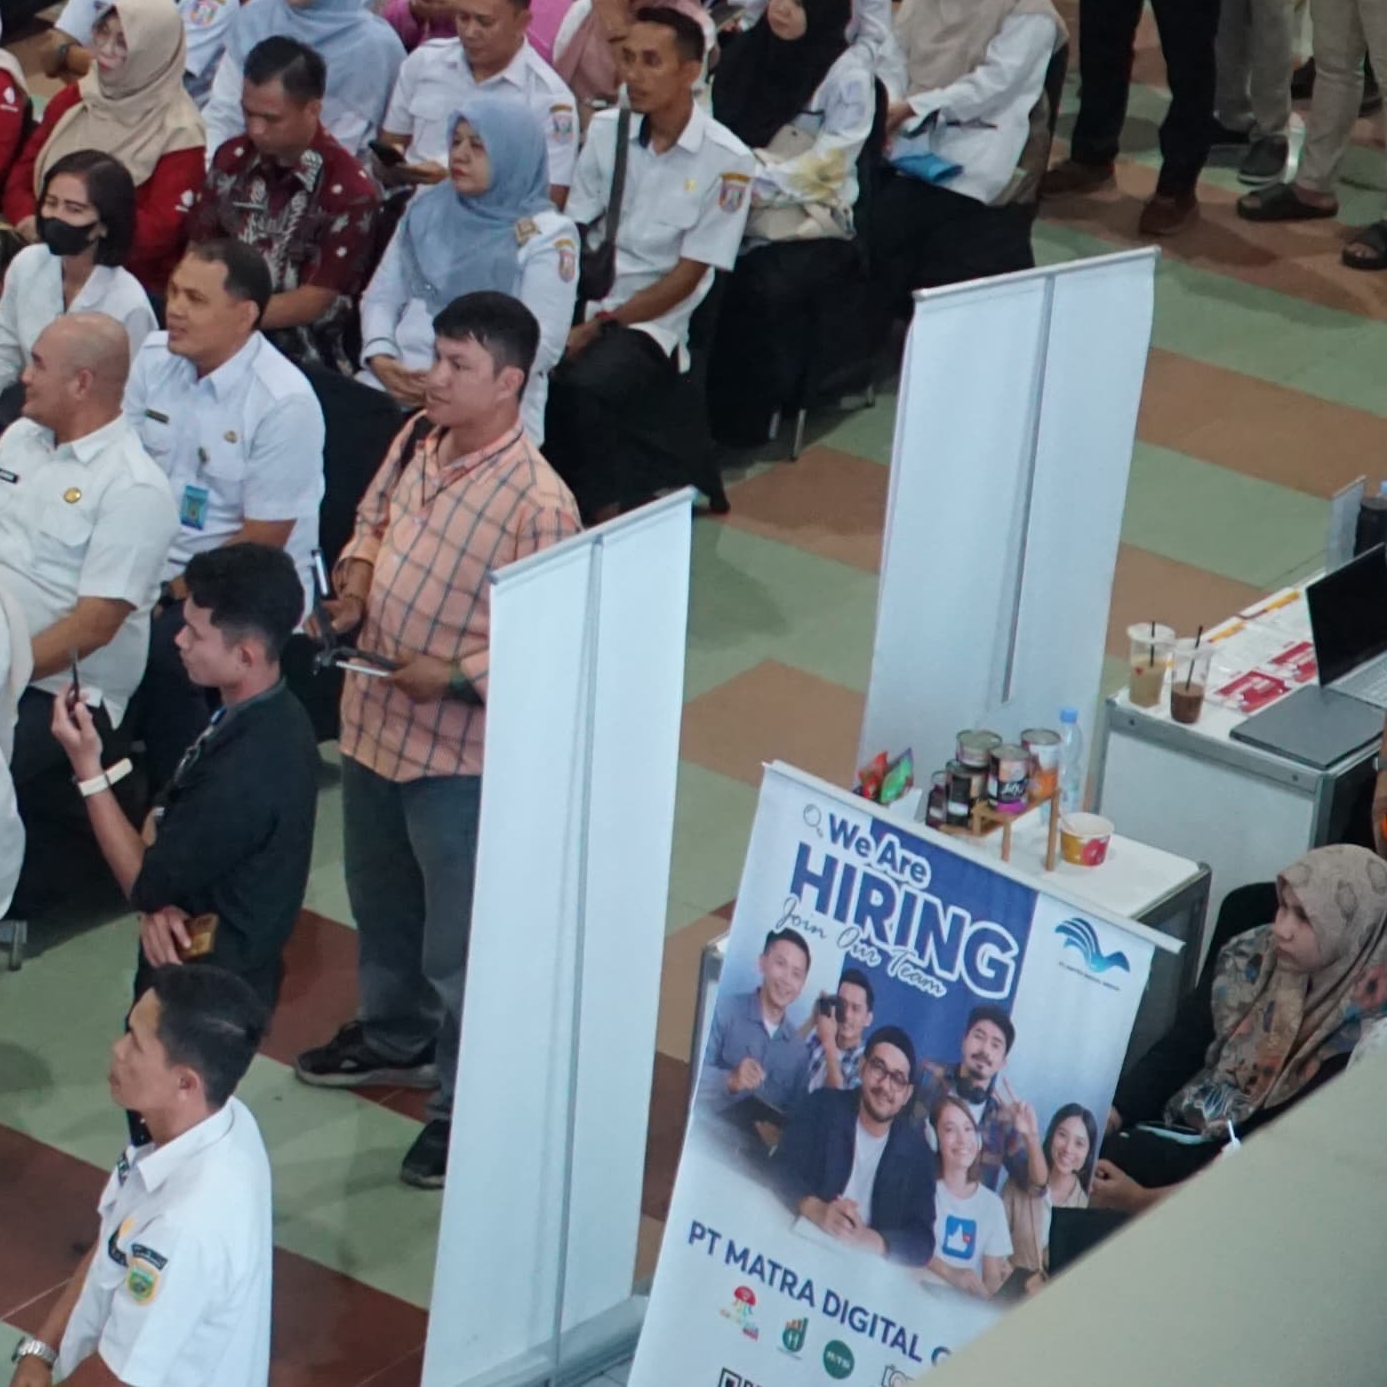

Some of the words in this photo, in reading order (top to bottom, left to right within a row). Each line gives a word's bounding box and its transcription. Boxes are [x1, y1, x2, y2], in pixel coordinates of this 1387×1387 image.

[829, 812, 872, 858] We
[877, 837, 929, 884] Are
[775, 897, 827, 941] Join
[836, 926, 882, 965] Our
[887, 948, 947, 998] Team
[788, 840, 1018, 999] HIRING
[688, 1219, 722, 1255] PT
[724, 1239, 816, 1308] MATRA
[822, 1288, 923, 1363] DIGITAL
